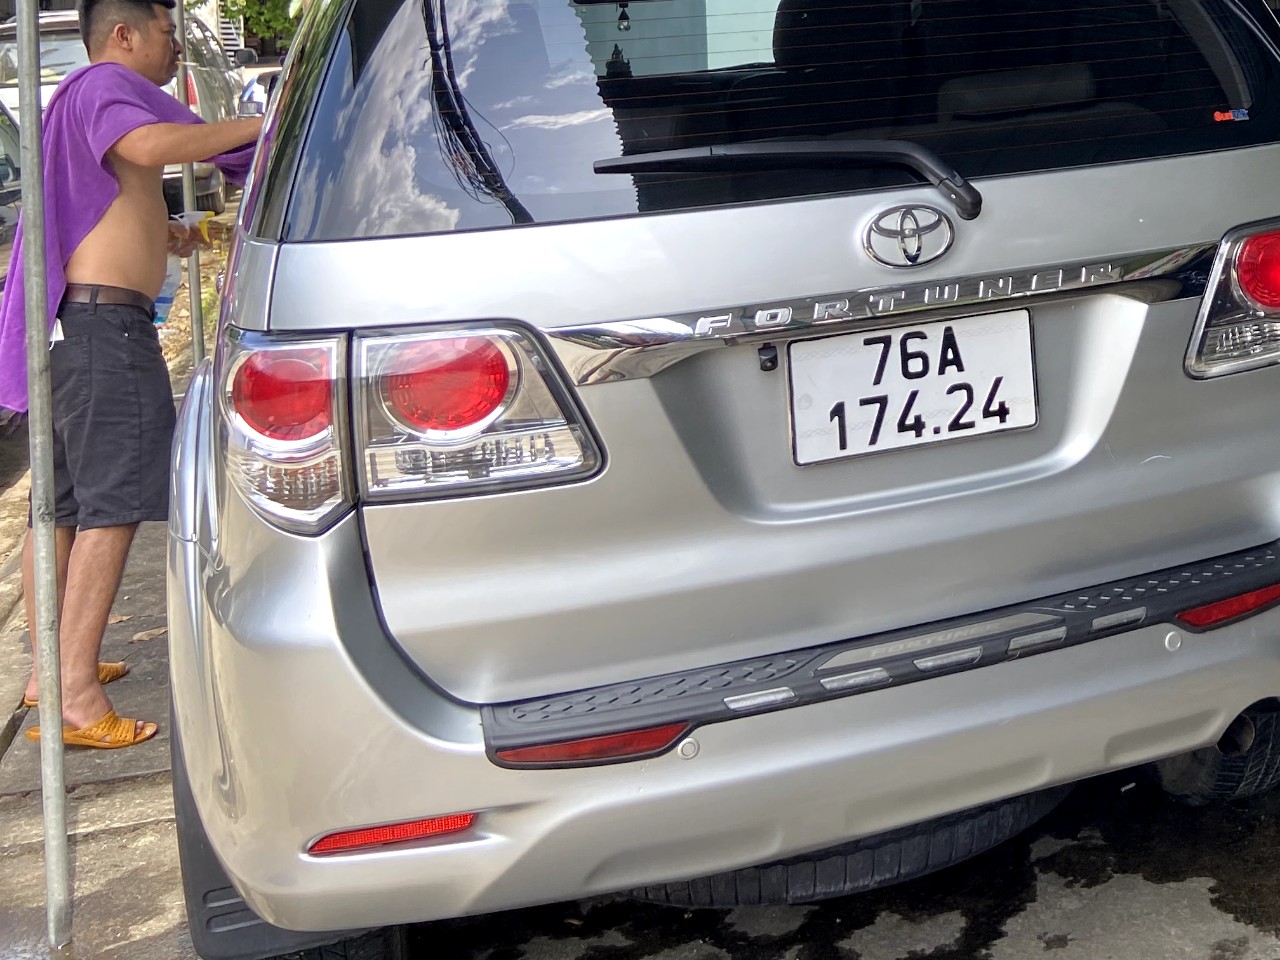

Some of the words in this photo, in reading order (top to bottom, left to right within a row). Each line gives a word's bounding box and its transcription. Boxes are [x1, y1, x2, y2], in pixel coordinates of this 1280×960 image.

[694, 262, 1114, 337] FORTUNER
[863, 326, 965, 386] 76A
[829, 376, 1010, 451] 174.24
